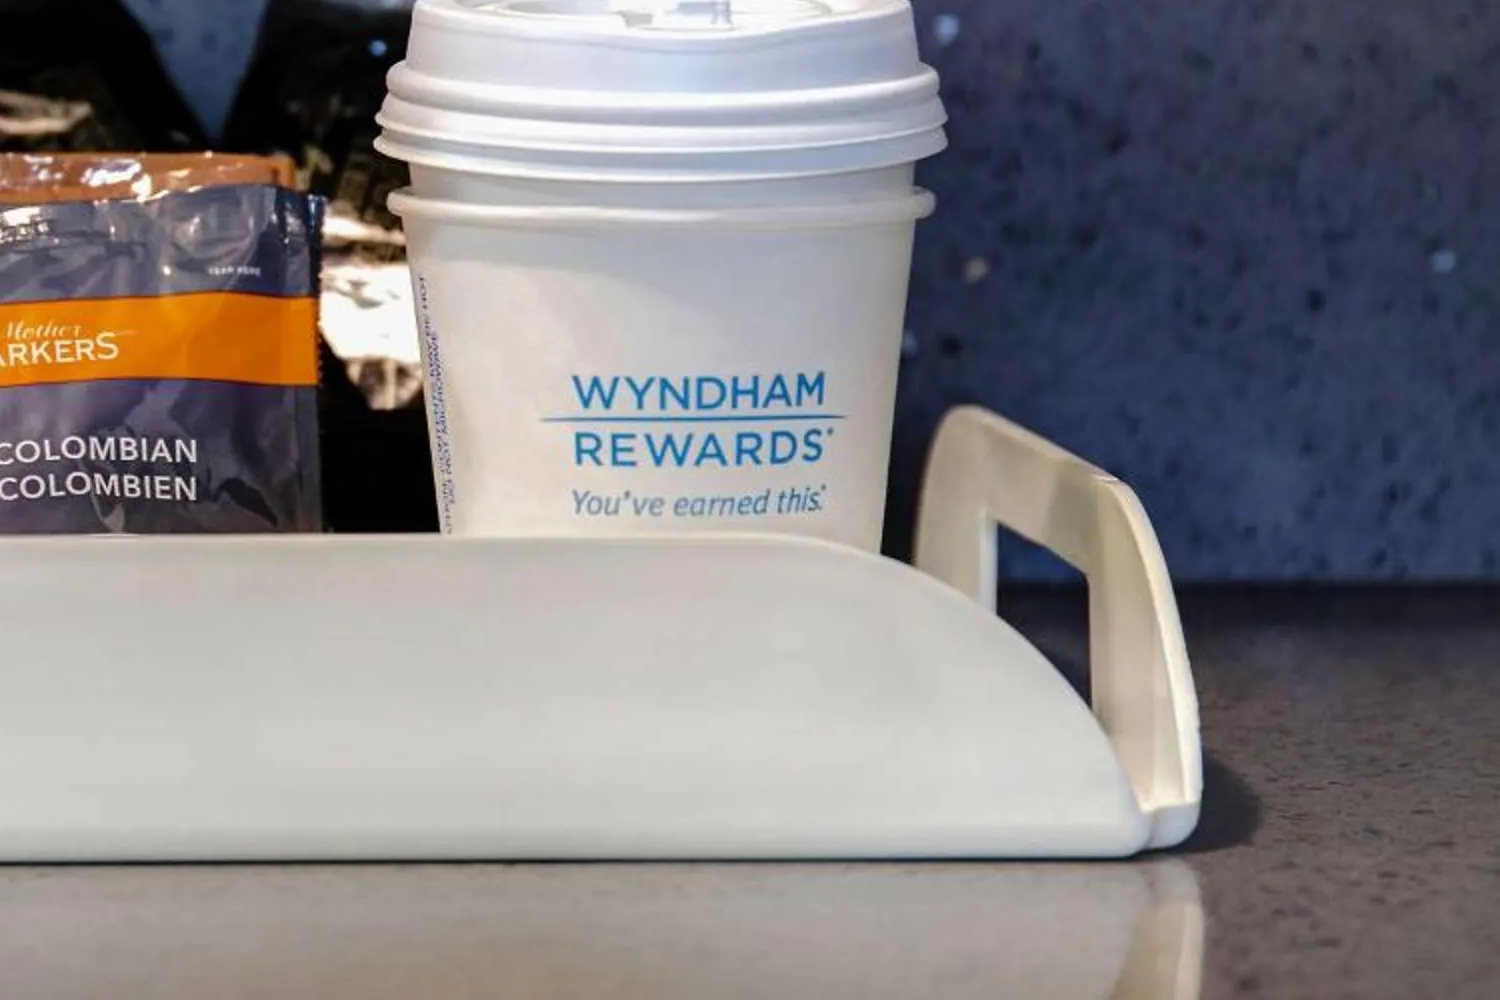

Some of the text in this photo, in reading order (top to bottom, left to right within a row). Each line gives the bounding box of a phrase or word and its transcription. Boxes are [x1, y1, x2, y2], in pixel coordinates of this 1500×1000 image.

[571, 371, 825, 410] WYNDHAM
[574, 428, 824, 467] REWARDS
[571, 488, 666, 516] You've
[672, 488, 771, 517] earned
